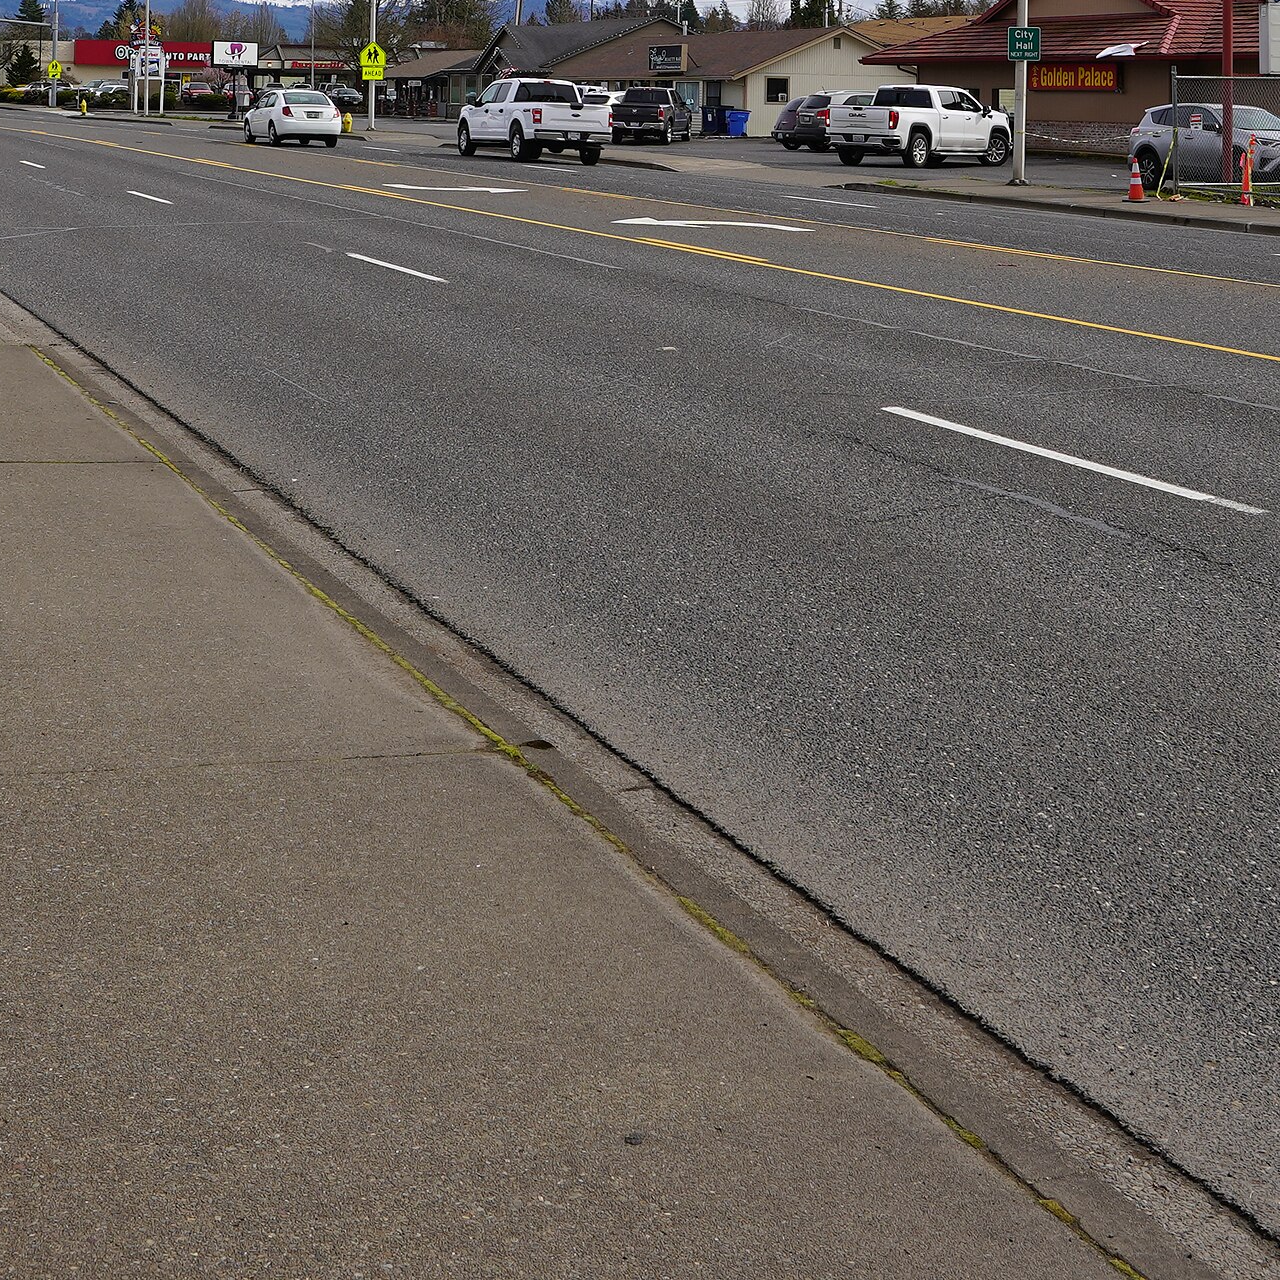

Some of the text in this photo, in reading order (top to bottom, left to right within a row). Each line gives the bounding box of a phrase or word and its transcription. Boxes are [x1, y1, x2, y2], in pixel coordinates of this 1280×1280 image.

[1014, 30, 1034, 40] City
[1015, 41, 1033, 50] Hall
[166, 52, 184, 61] UTO
[187, 52, 211, 61] PART
[1040, 66, 1114, 87] Golden Palace
